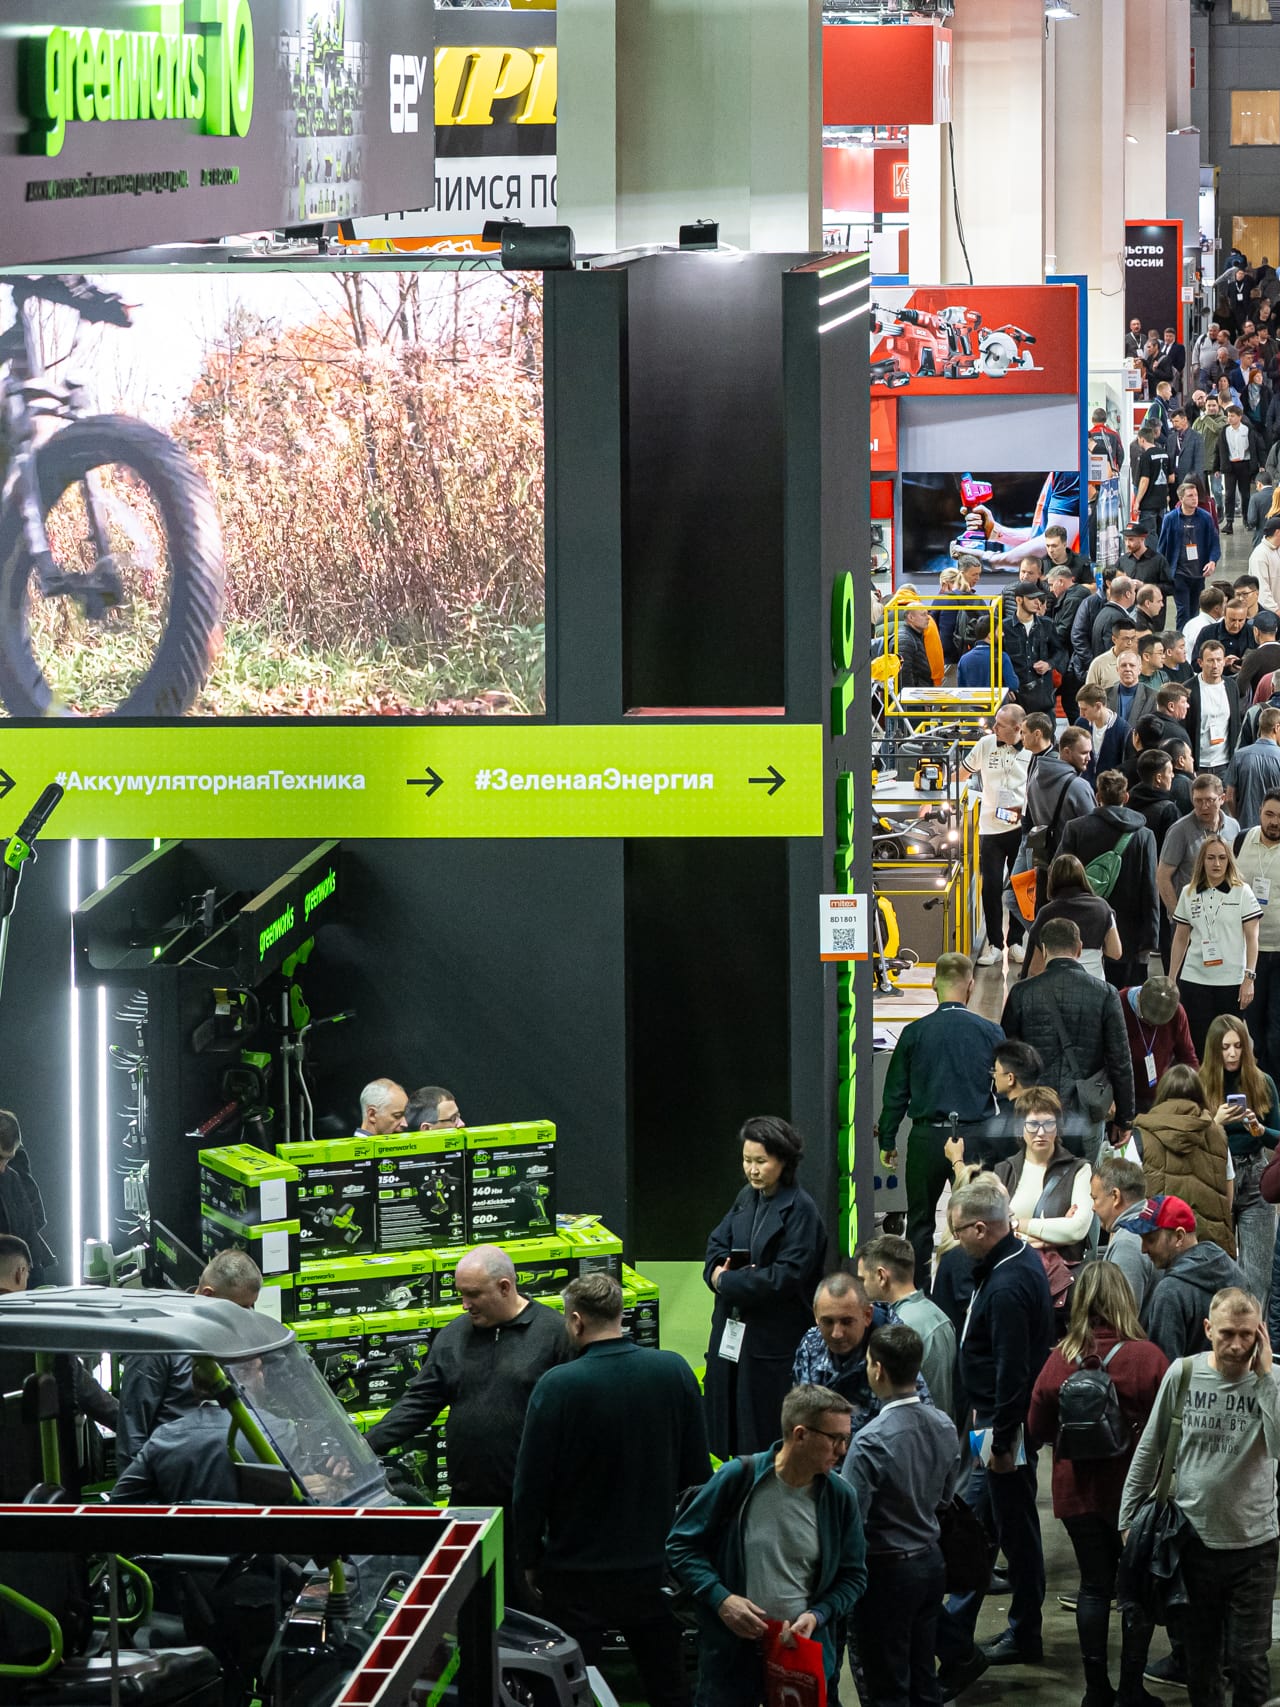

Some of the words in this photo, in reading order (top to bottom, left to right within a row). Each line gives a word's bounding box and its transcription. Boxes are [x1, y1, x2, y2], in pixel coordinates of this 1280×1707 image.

[46, 2, 205, 157] greenworks
[385, 175, 521, 220] ЛИМСЯ
[53, 770, 365, 796] #АккумуляторнаяТехника
[474, 767, 714, 794] #ЗеленаяЭнергия
[304, 866, 336, 923] greenworks
[259, 902, 295, 962] greenworks
[378, 1143, 417, 1154] greenworks
[471, 1197, 516, 1207] Anti-Kickback
[472, 1214, 498, 1224] 600+
[301, 1273, 336, 1282] greenworks
[368, 1380, 389, 1388] 650+
[1184, 1390, 1218, 1409] AMP
